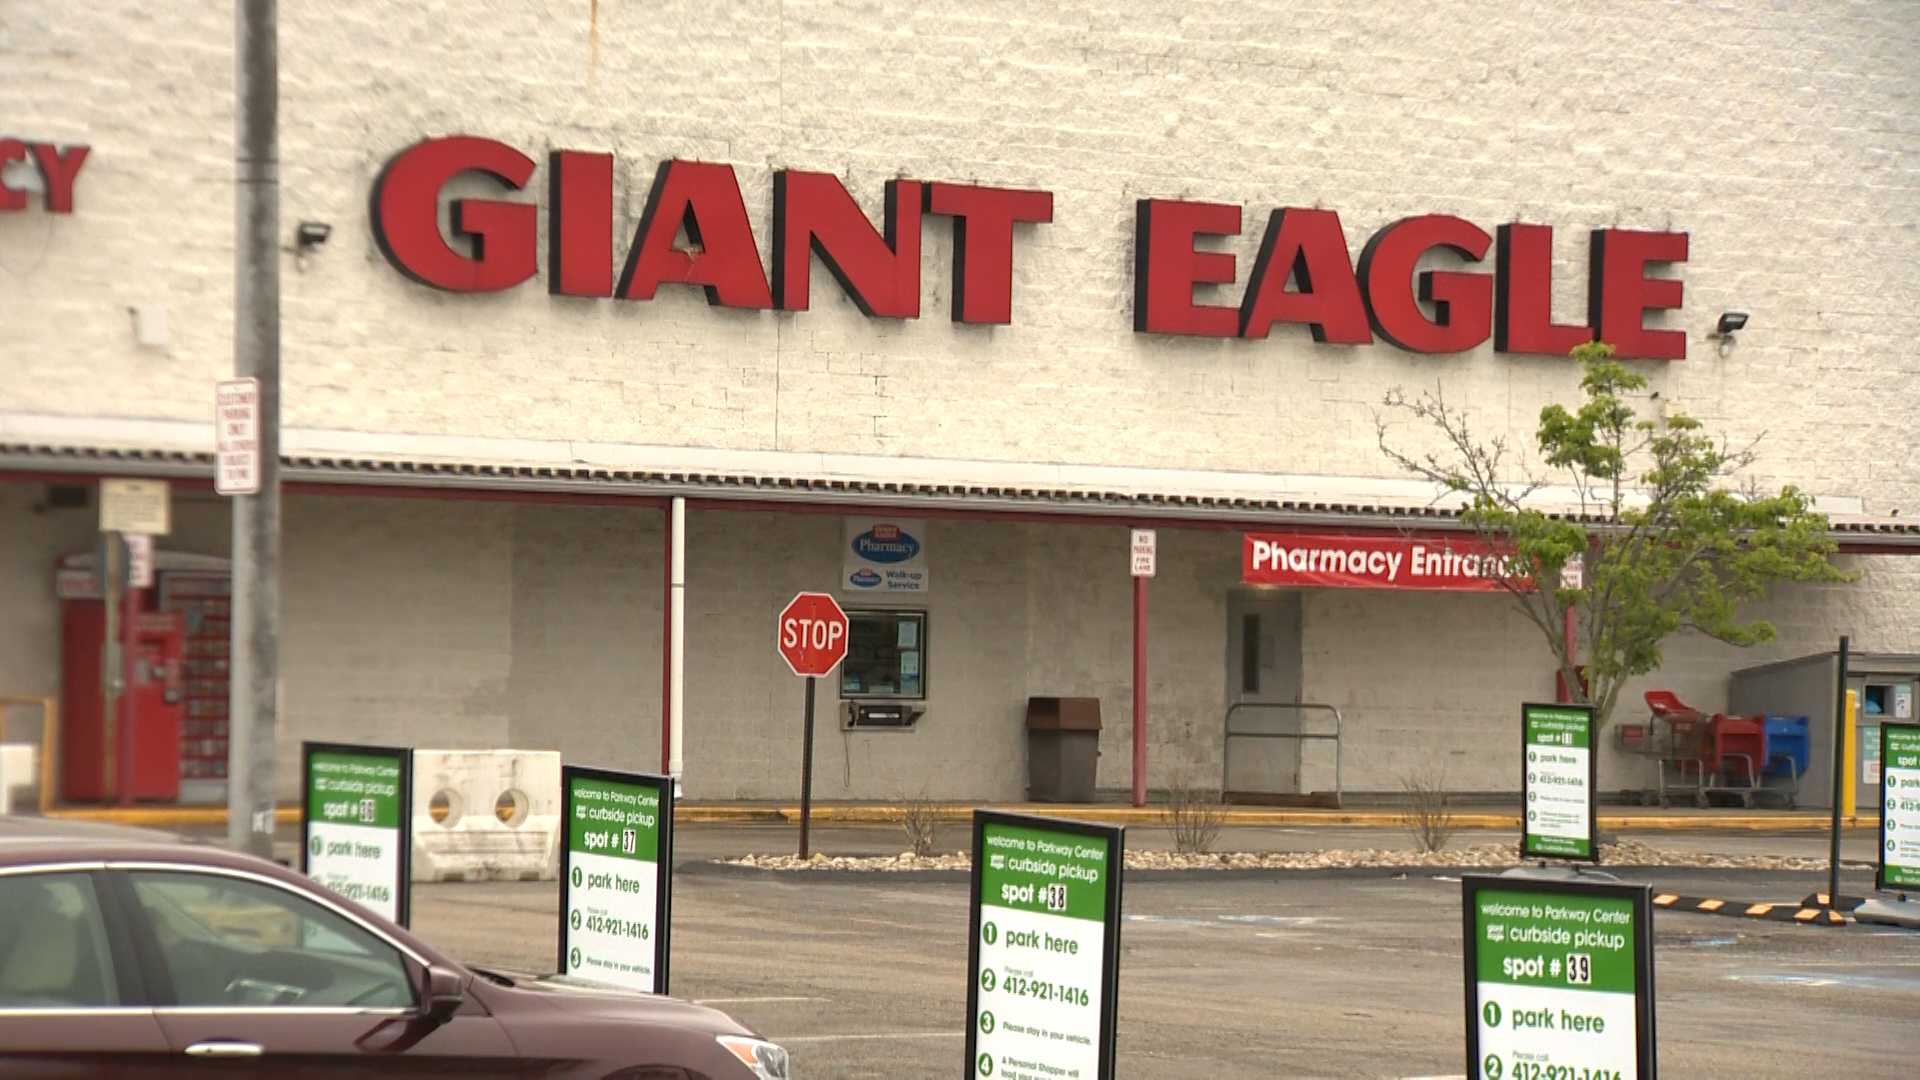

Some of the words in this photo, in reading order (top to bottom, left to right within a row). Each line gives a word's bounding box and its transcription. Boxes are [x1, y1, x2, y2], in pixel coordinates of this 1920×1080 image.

[370, 134, 1053, 326] GIANT
[1134, 198, 1688, 361] EAGLE
[860, 538, 915, 558] Pharmacy
[1253, 540, 1403, 582] Pharmacy
[887, 581, 920, 590] Service
[784, 618, 843, 650] STOP
[323, 801, 349, 819] spot
[574, 788, 602, 800] welcome
[603, 791, 610, 801] to
[611, 791, 637, 806] Parkway
[637, 794, 659, 807] Center
[589, 806, 625, 822] curbside
[626, 811, 654, 829] pickup
[327, 841, 352, 857] park
[355, 841, 381, 860] here
[584, 830, 608, 850] spot
[611, 833, 619, 848] #
[623, 831, 635, 852] 37
[986, 835, 1025, 850] welcome
[1027, 839, 1035, 851] to
[1037, 840, 1073, 859] Parkway
[1074, 845, 1104, 860] Center
[588, 872, 612, 891] park
[615, 873, 640, 894] here
[1008, 857, 1056, 876] curbside
[1058, 864, 1098, 884] pickup
[1001, 883, 1034, 904] spot
[1049, 887, 1065, 908] 38
[1481, 903, 1529, 918] welcome
[1531, 905, 1543, 918] to
[1545, 905, 1590, 924] Parkway
[1593, 909, 1630, 924] Center
[586, 915, 649, 940] 412-921-1416
[1510, 925, 1570, 944] curbside
[1574, 929, 1625, 951] pickup
[1006, 930, 1040, 948] park
[1044, 932, 1078, 955] here
[1503, 955, 1544, 979] spot
[1549, 959, 1561, 978] #
[1568, 956, 1589, 981] 39
[1003, 975, 1089, 1007] 412-921-1416
[1002, 1021, 1025, 1034] Please
[1026, 1024, 1040, 1037] stay
[1050, 1031, 1064, 1041] your
[1512, 1007, 1555, 1030] park
[1561, 1008, 1605, 1034] here
